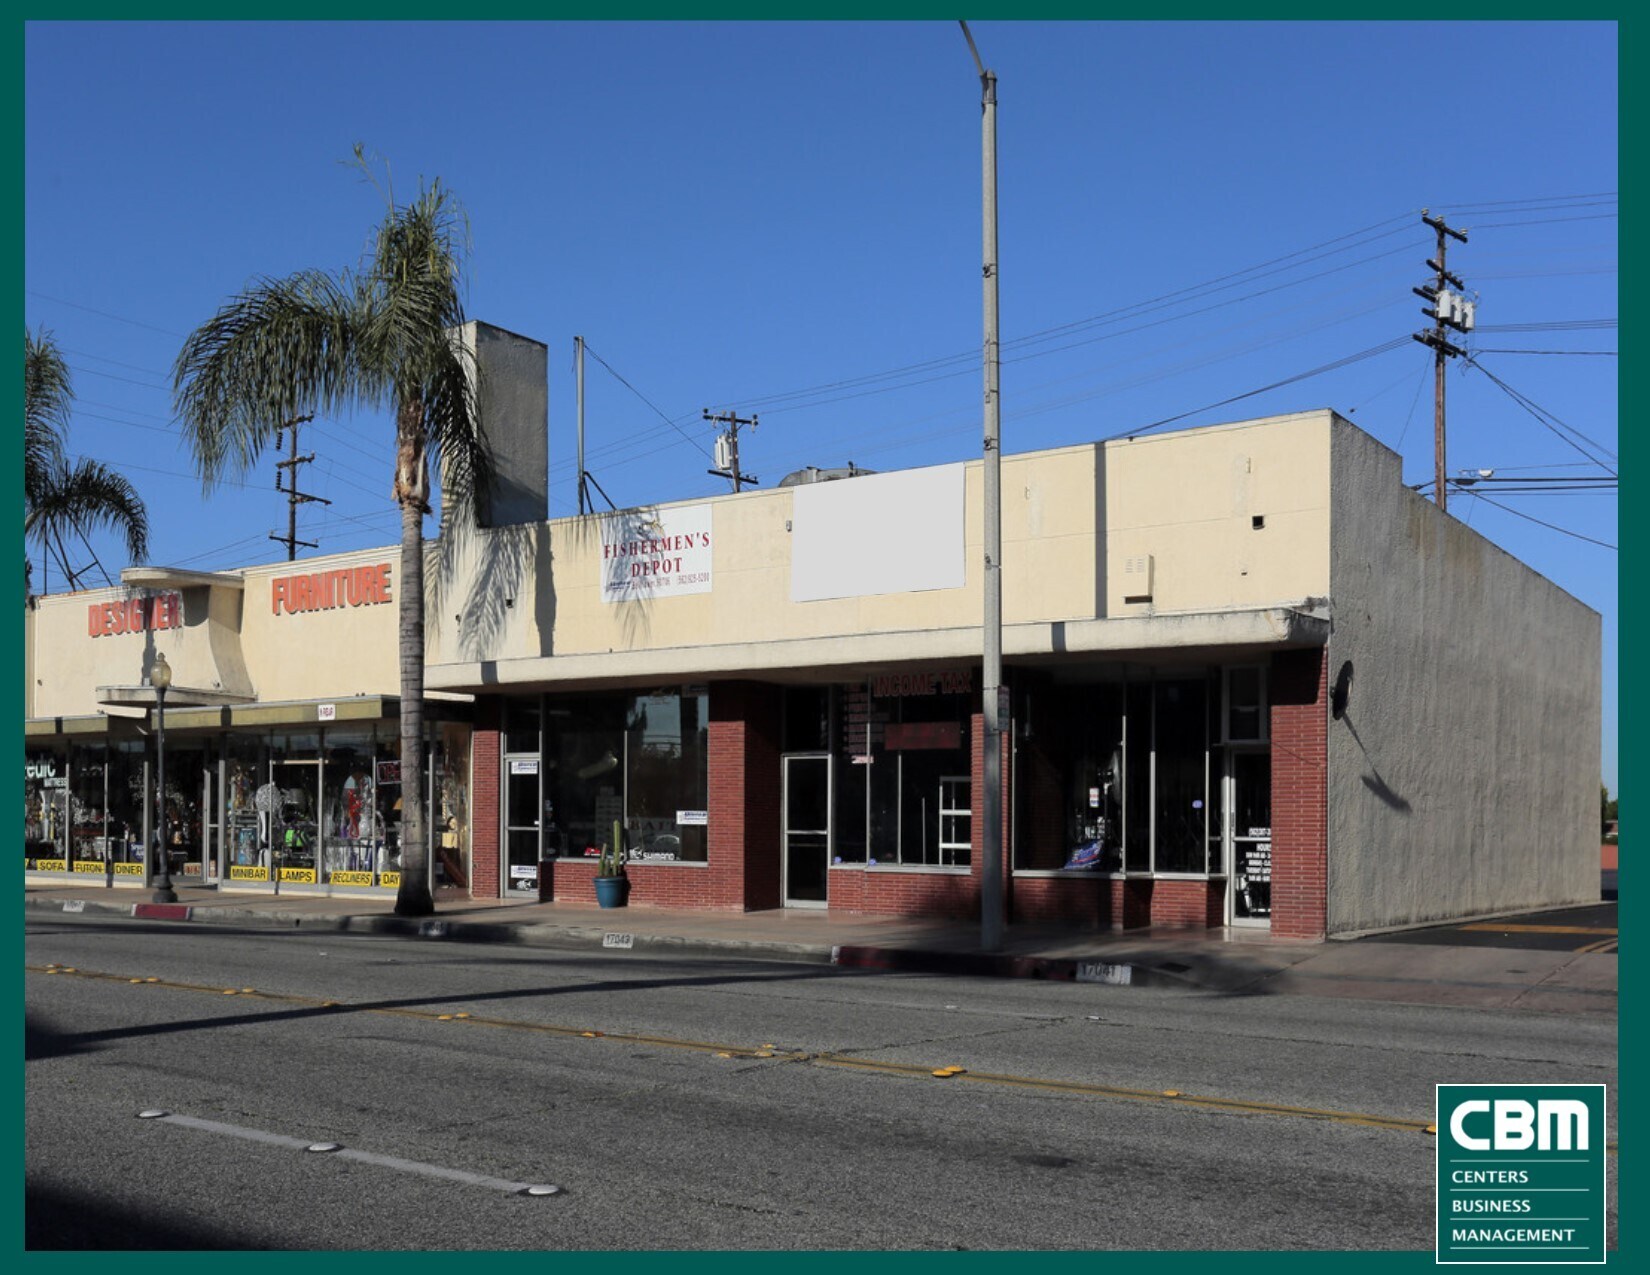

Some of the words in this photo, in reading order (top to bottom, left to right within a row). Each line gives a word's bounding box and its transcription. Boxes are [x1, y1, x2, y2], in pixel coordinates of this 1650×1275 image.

[604, 532, 710, 559] FISHERMEN'S
[631, 557, 683, 578] DEPOT
[272, 563, 393, 616] FURNITURE
[88, 594, 183, 638] DESIGNER
[873, 673, 937, 697] INCOME
[941, 671, 973, 694] TAX
[25, 754, 56, 779] edic
[39, 861, 65, 871] SOFA
[115, 865, 143, 875] DINER
[232, 867, 266, 879] MINIBAR
[280, 869, 312, 882] LAMPS
[333, 872, 371, 884] RECLINERS
[383, 873, 400, 885] DAY
